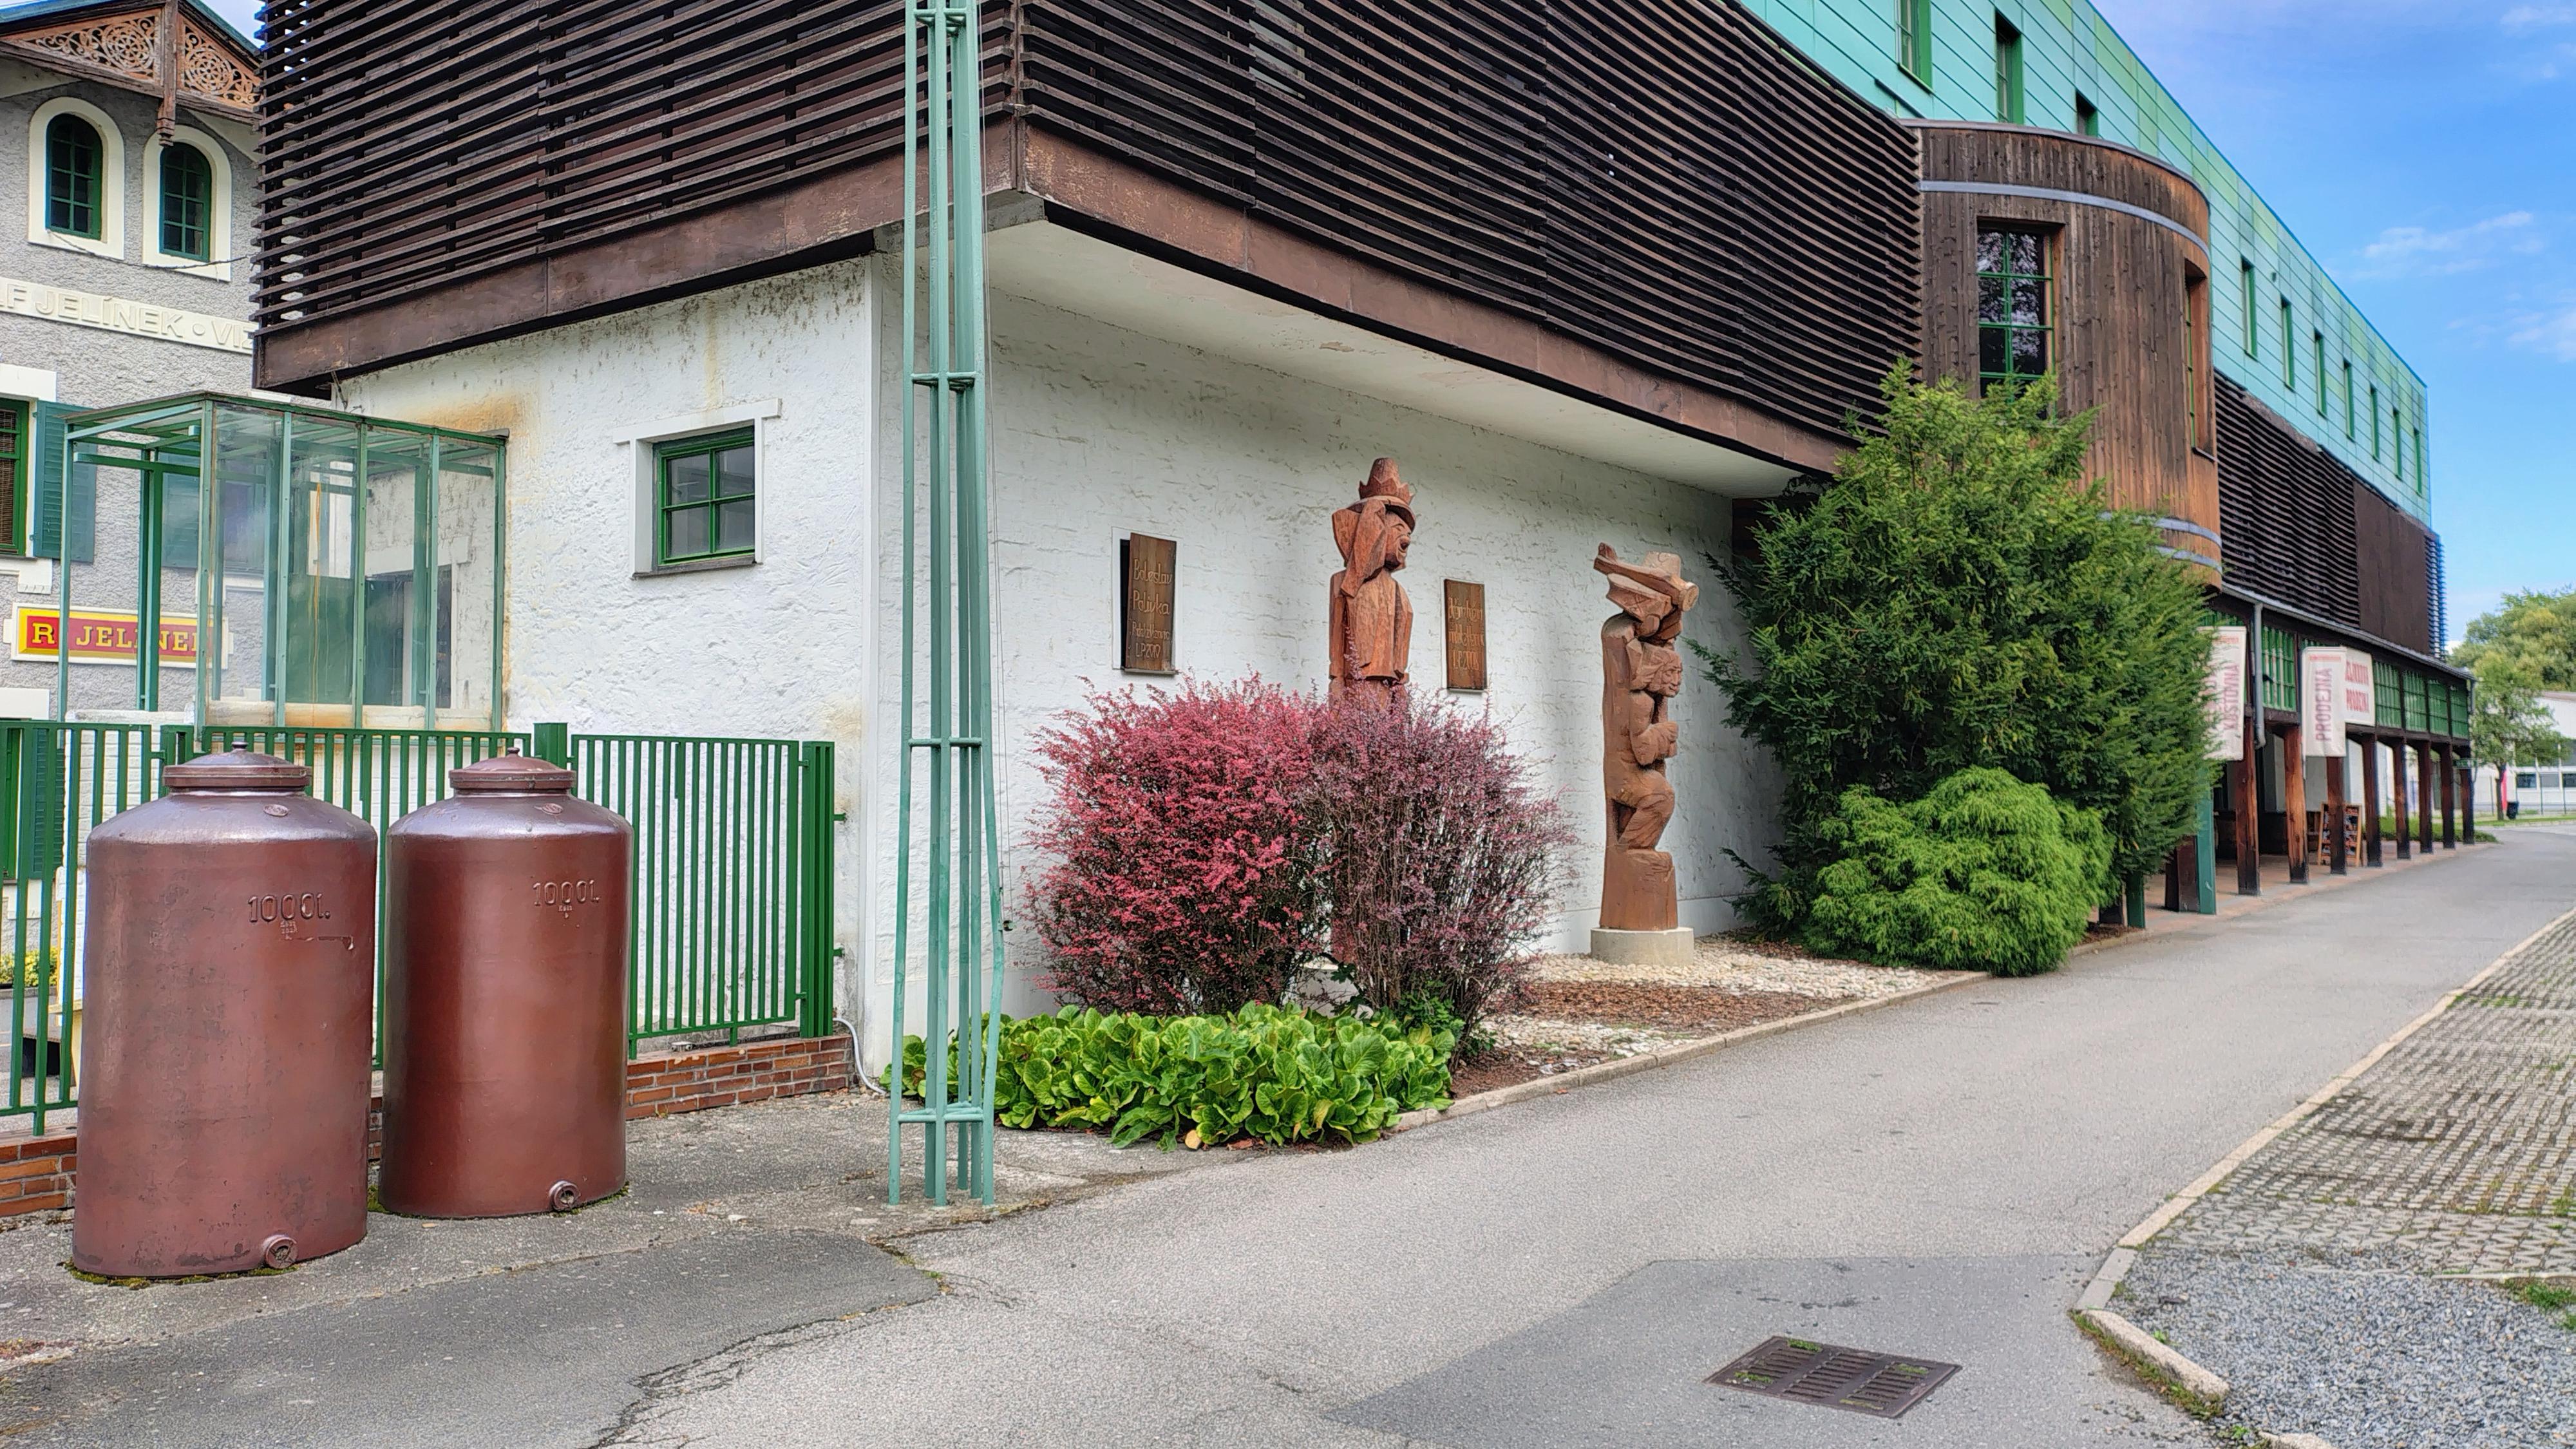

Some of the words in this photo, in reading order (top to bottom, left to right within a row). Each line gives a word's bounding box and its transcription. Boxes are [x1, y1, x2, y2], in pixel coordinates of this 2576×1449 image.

[35, 290, 184, 338] JELÍNEK
[1133, 558, 1172, 585] Boleslav
[2315, 668, 2332, 741] PRODEJNA
